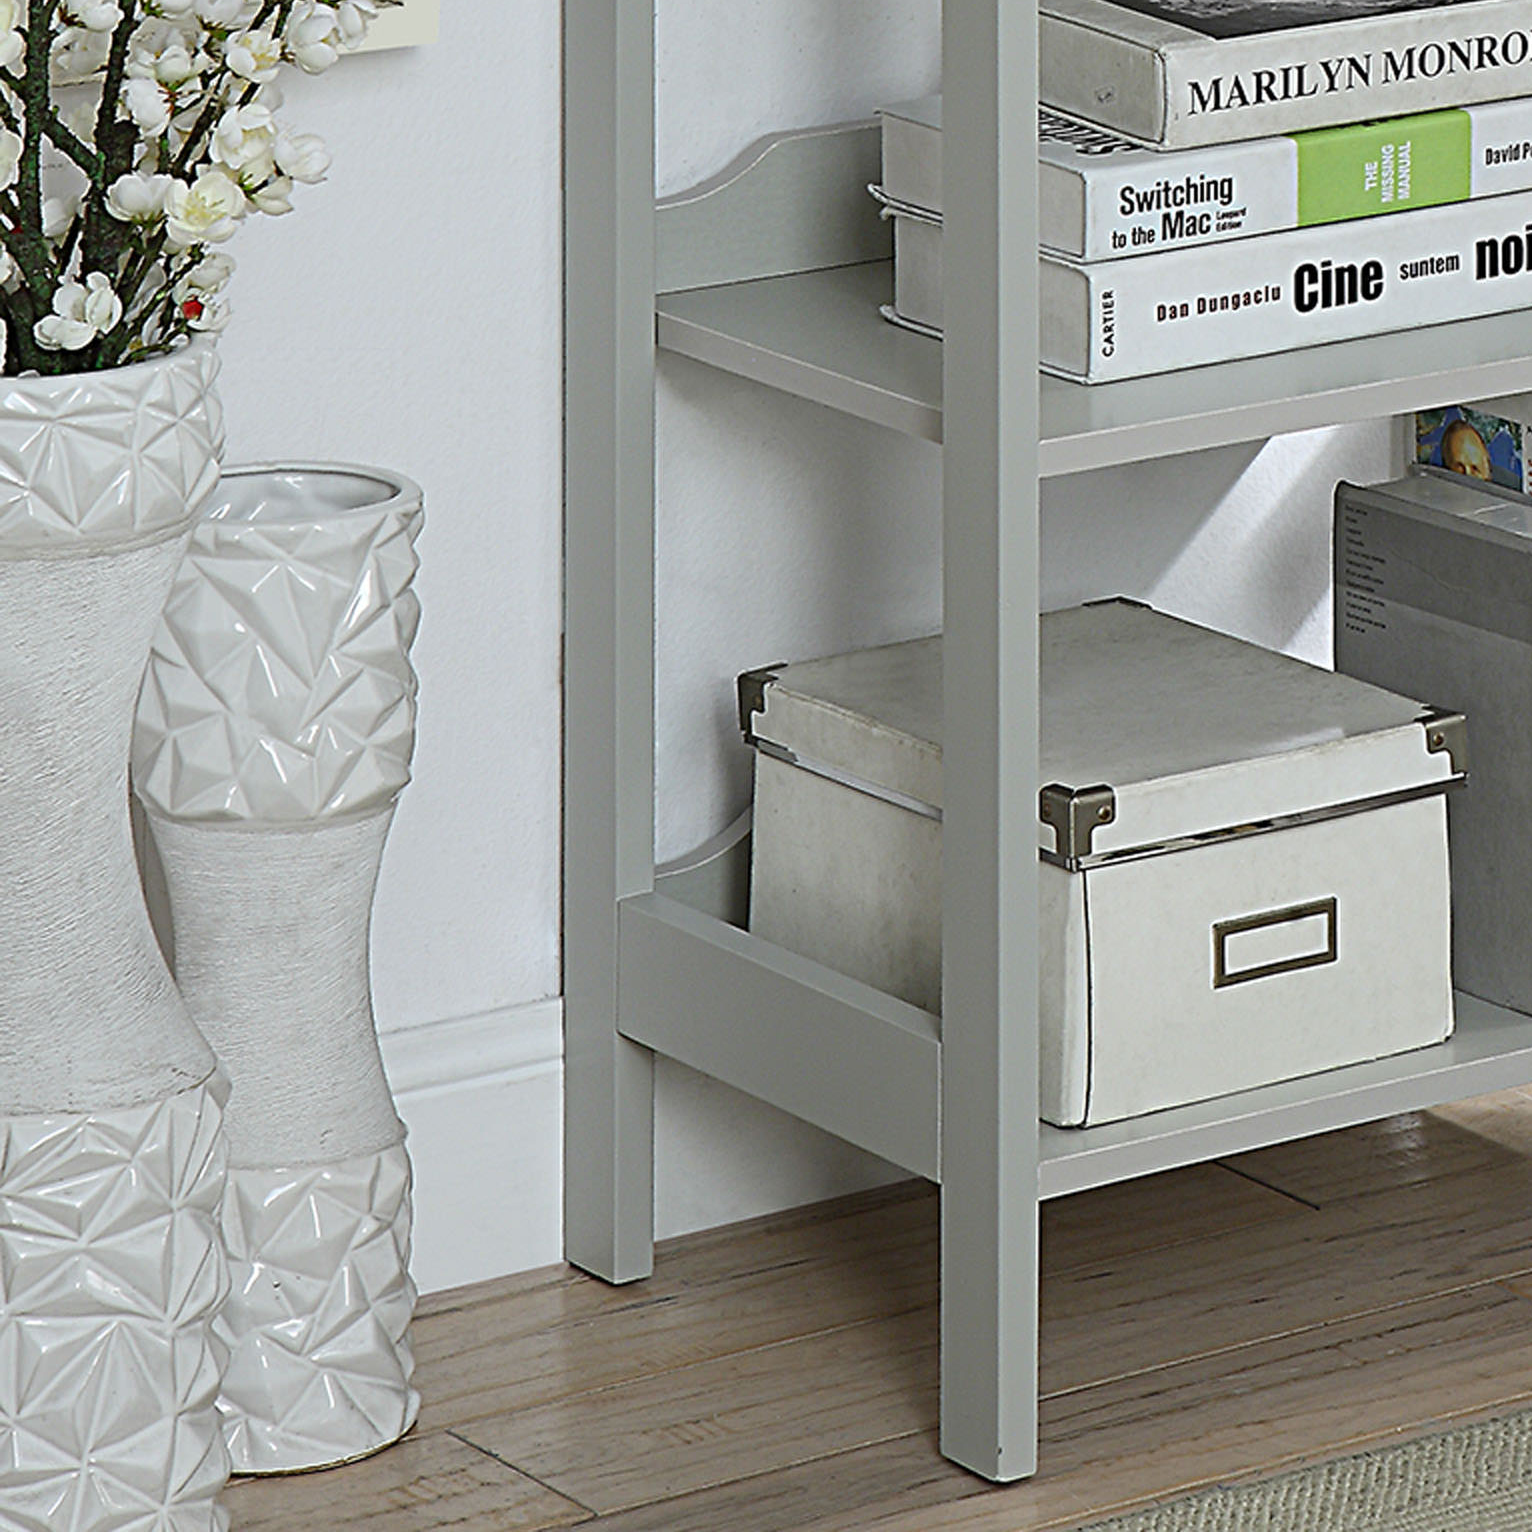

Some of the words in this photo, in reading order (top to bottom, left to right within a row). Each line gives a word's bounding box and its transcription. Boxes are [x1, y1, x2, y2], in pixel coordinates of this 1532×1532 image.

[1187, 53, 1371, 117] MARILYN
[1364, 161, 1378, 192] THE
[1380, 143, 1395, 203] MISSING
[1397, 140, 1412, 200] MANUAL
[1485, 144, 1520, 166] David
[1118, 174, 1234, 216] Switching
[1111, 230, 1128, 249] to
[1131, 226, 1156, 246] the
[1160, 209, 1211, 242] Mac
[1156, 302, 1190, 322] Dan
[1196, 284, 1282, 315] Dungaciu
[1293, 259, 1384, 313] Cine
[1400, 253, 1460, 280] suntem
[1101, 289, 1115, 358] CARTIER
